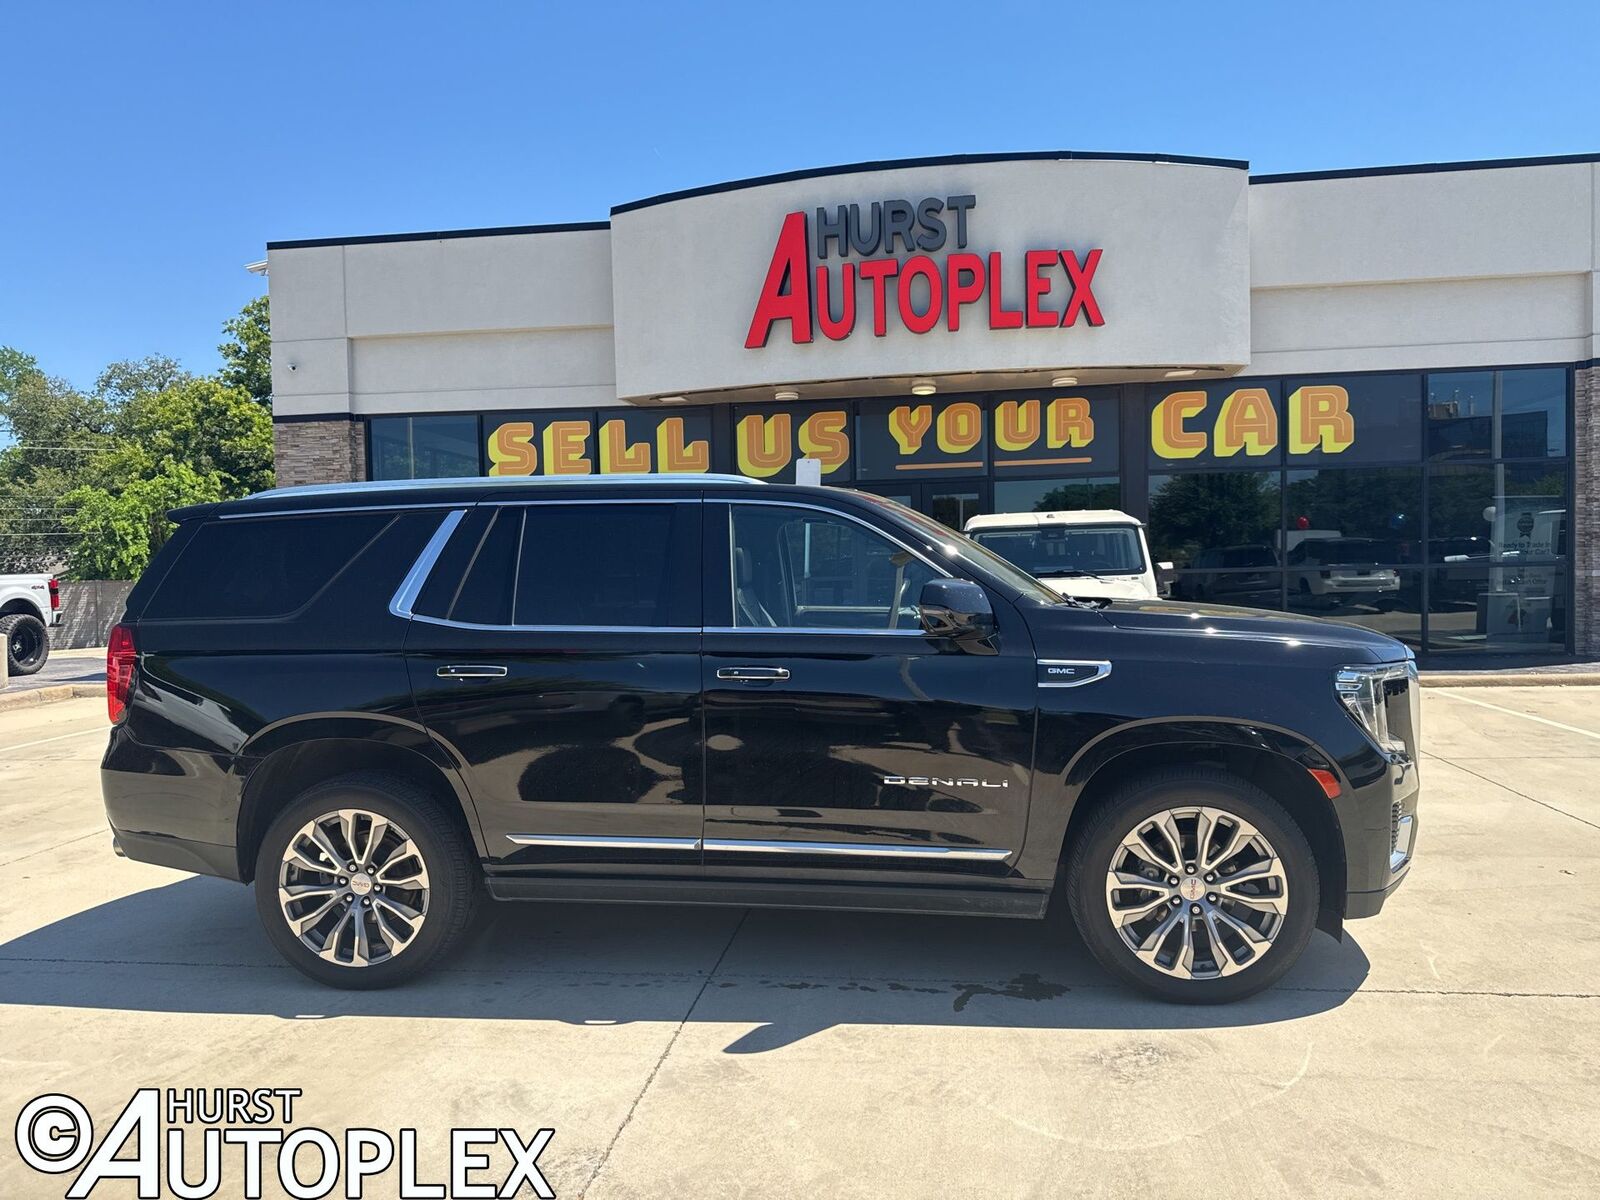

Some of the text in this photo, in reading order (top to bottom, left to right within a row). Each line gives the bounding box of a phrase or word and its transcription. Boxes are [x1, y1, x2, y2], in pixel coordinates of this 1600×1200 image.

[816, 194, 976, 259] HURST
[744, 211, 1106, 349] AUTOPLEX
[487, 385, 1355, 477] SELL US YOUR CAR
[1047, 667, 1075, 675] GMC
[883, 775, 1009, 788] DENALI
